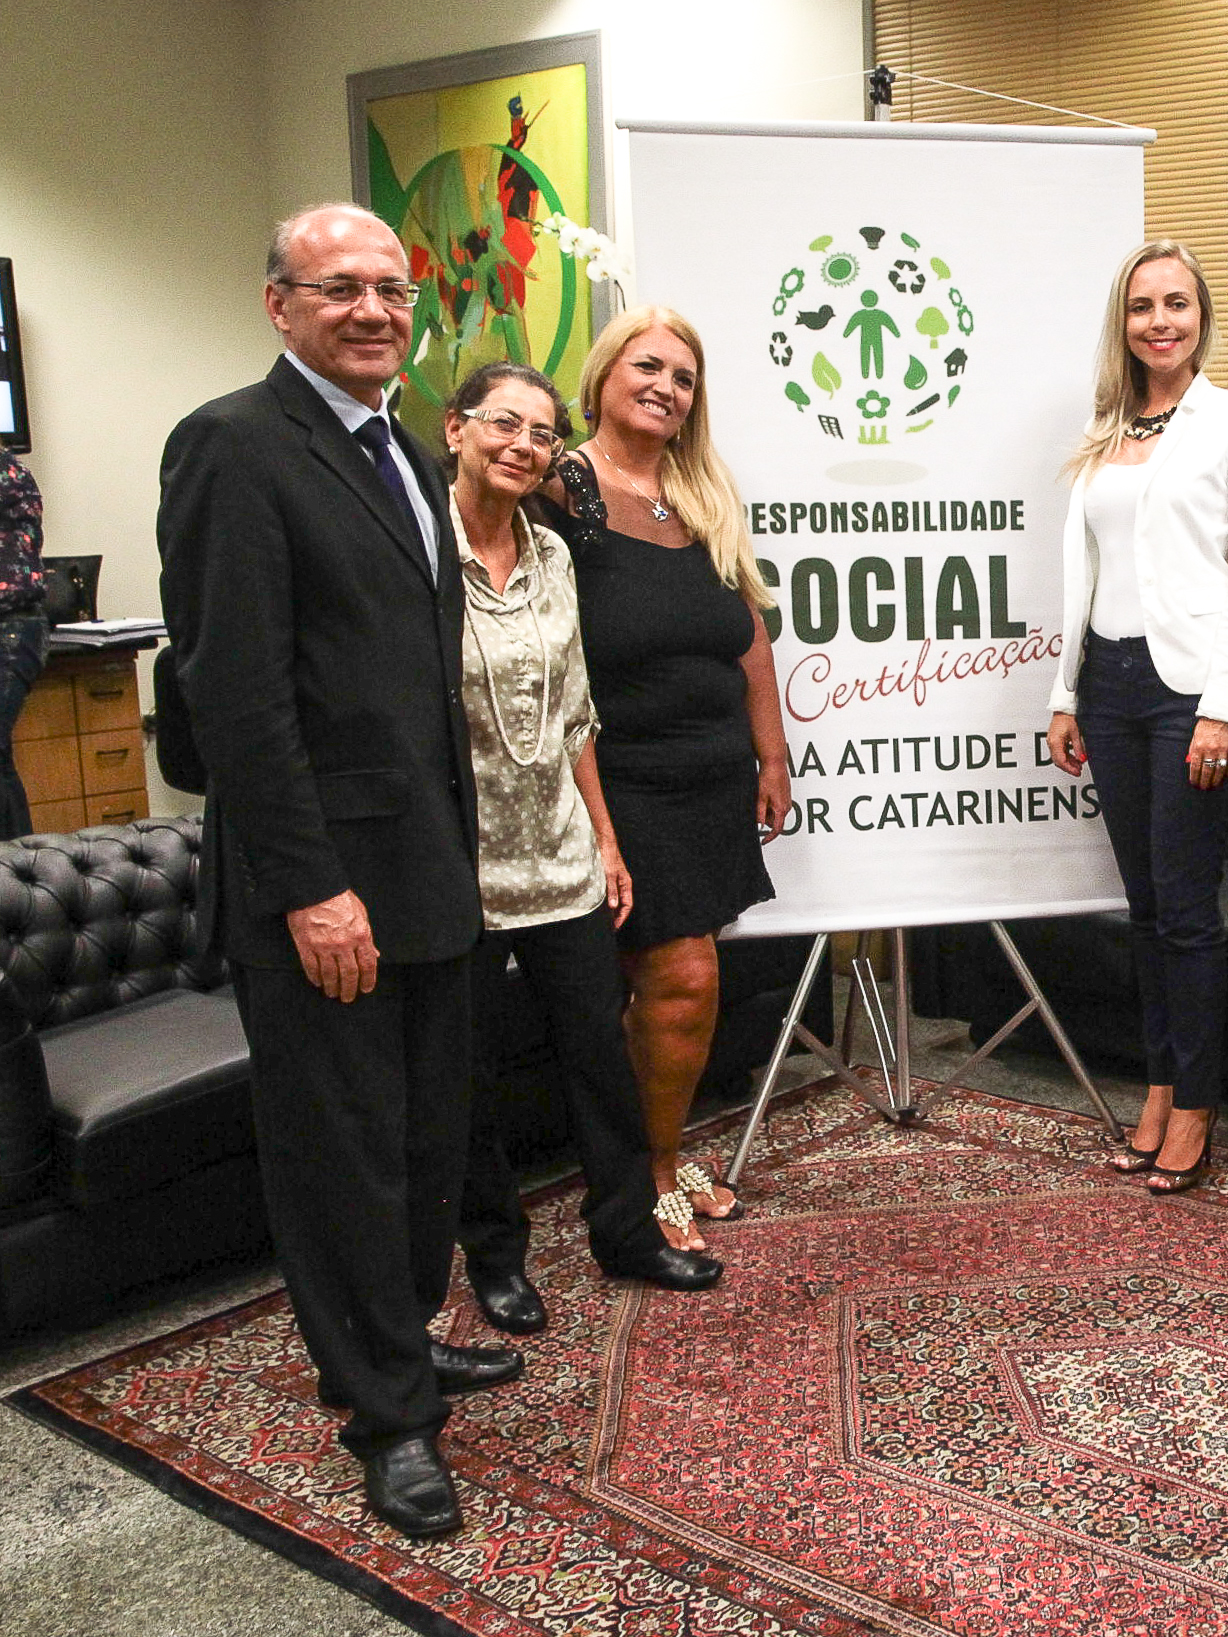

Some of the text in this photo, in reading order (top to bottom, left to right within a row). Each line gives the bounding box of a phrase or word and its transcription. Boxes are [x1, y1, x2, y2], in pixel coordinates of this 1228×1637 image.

[743, 499, 1025, 535] ESPONSABILIDADE
[785, 627, 1063, 723] Certificação
[836, 732, 1018, 776] ATITUDE
[848, 783, 1101, 832] CATARINENS
